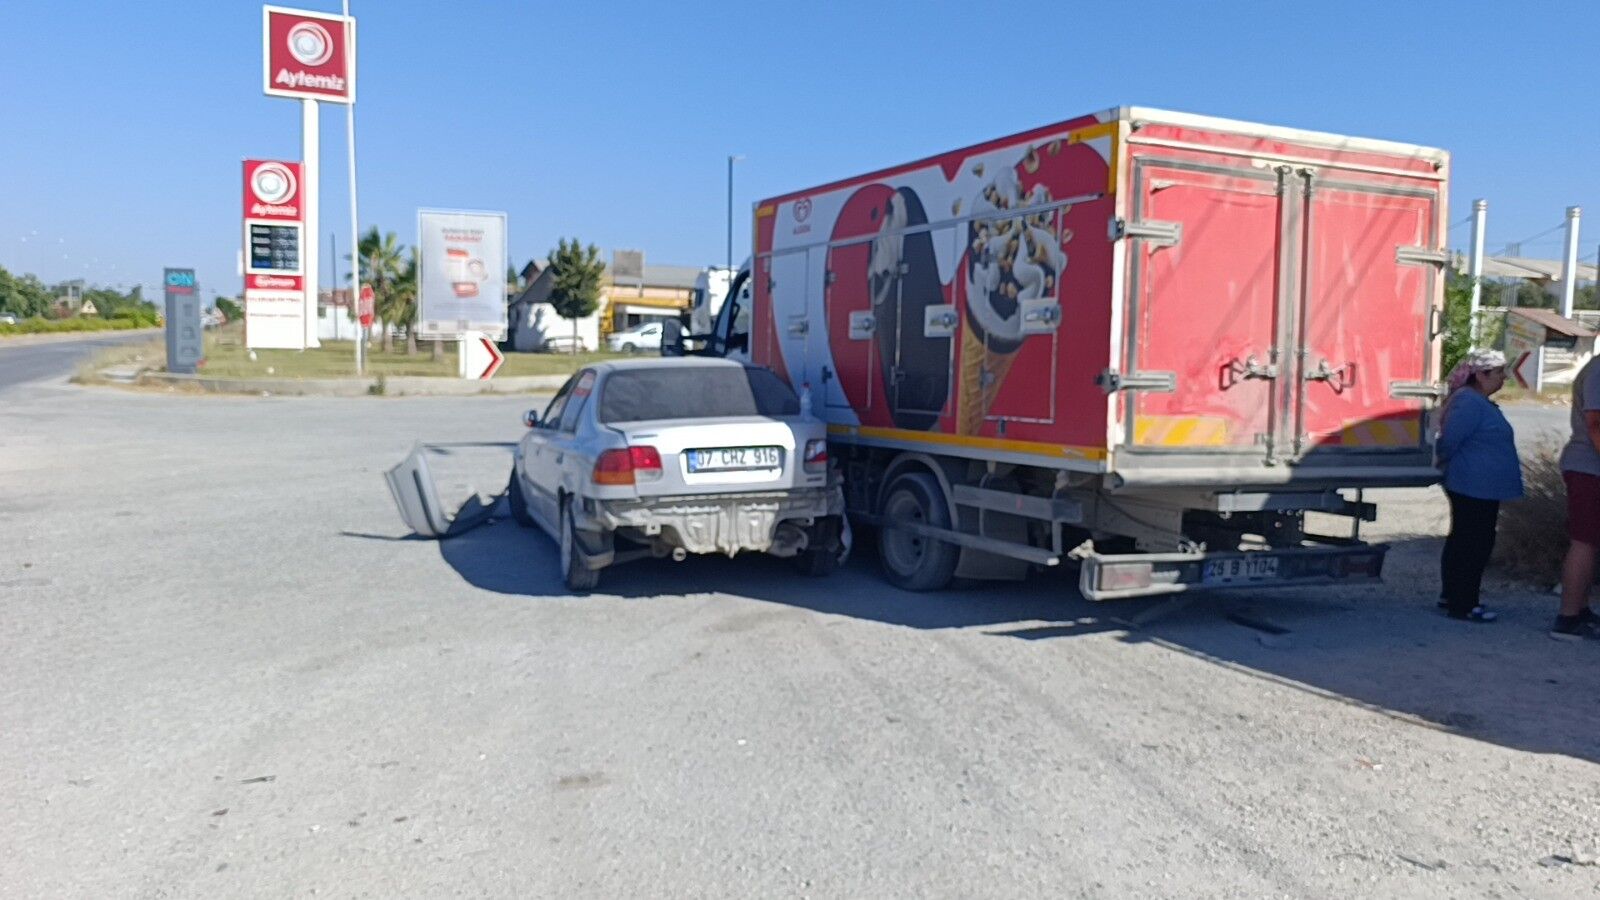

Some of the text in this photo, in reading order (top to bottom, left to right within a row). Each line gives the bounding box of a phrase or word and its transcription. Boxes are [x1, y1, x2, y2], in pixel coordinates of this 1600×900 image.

[275, 68, 345, 91] Aytemiz
[697, 447, 777, 466] 07 CHZ 916
